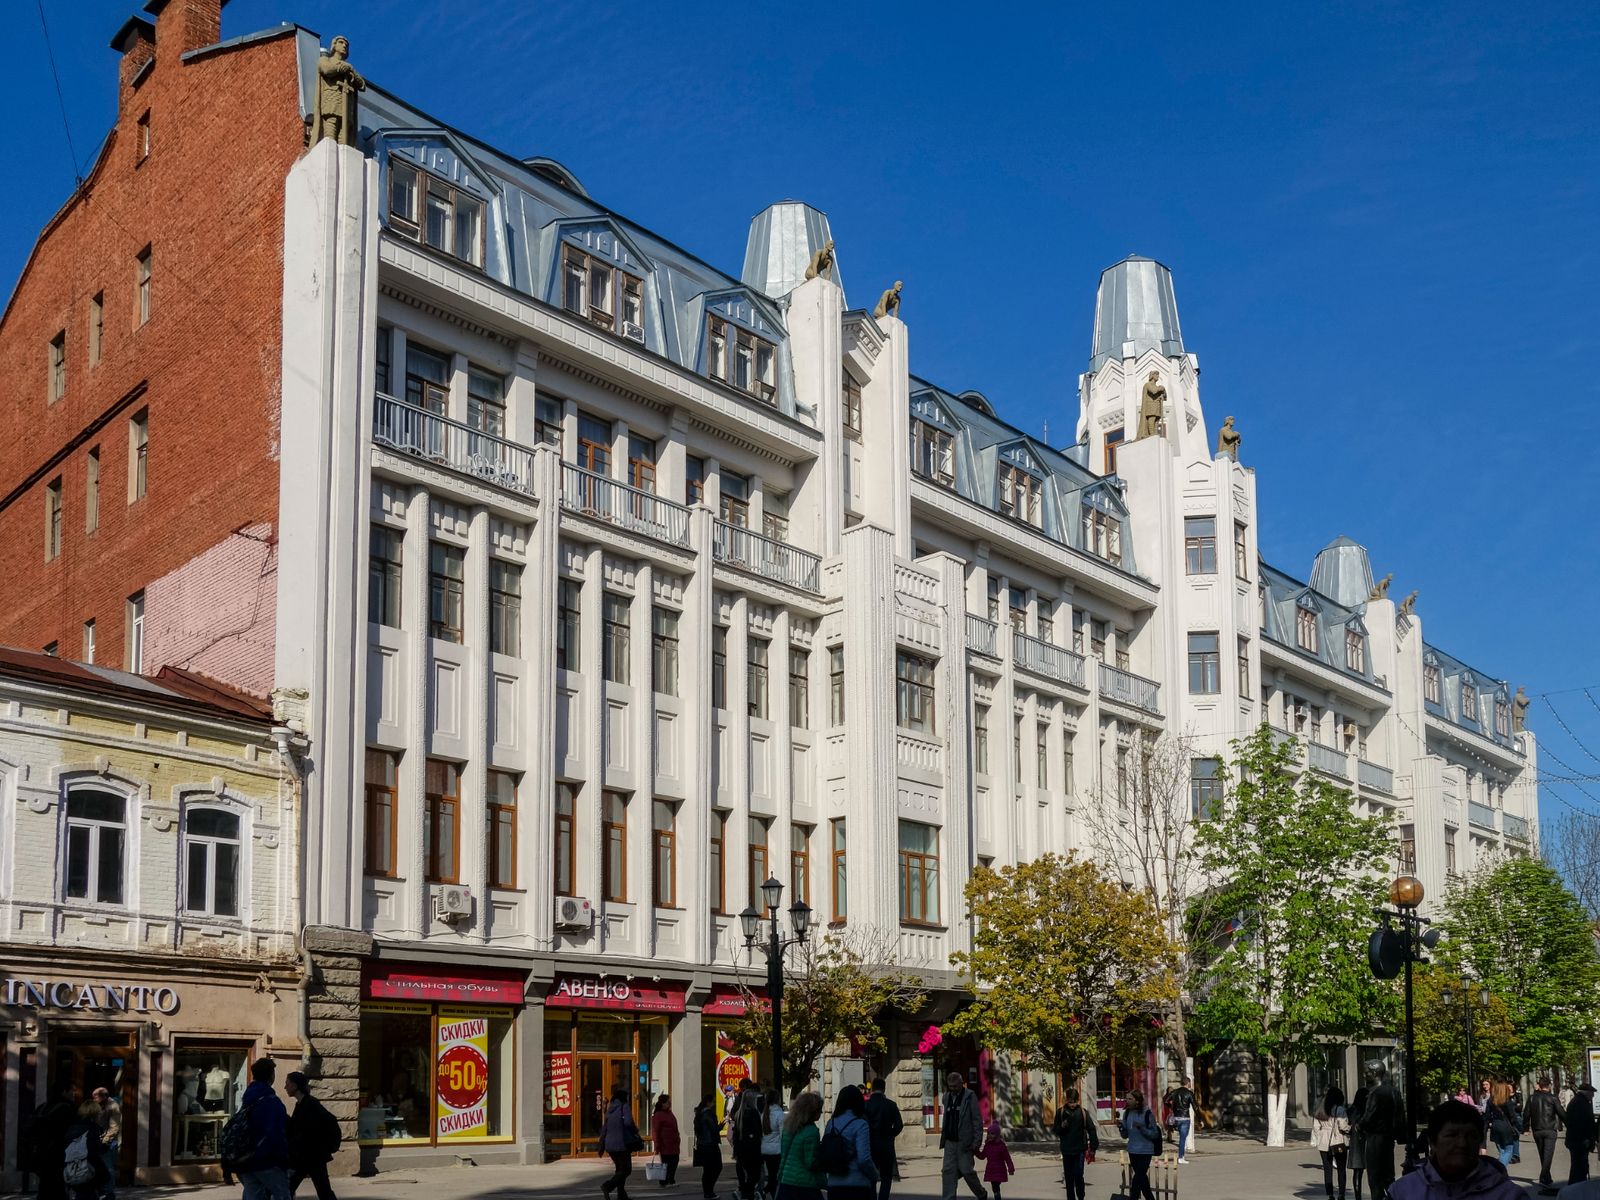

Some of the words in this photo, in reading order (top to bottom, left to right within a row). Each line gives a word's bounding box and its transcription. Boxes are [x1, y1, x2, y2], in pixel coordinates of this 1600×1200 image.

[5, 978, 178, 1013] INCANTO
[457, 983, 499, 993] обувь
[556, 978, 630, 1000] АВЕНЮ
[440, 1018, 485, 1042] СКИДКИ
[543, 1056, 569, 1069] ЕСНА
[724, 1064, 745, 1076] ВЕСНА
[440, 1108, 484, 1133] СКИДКИ
